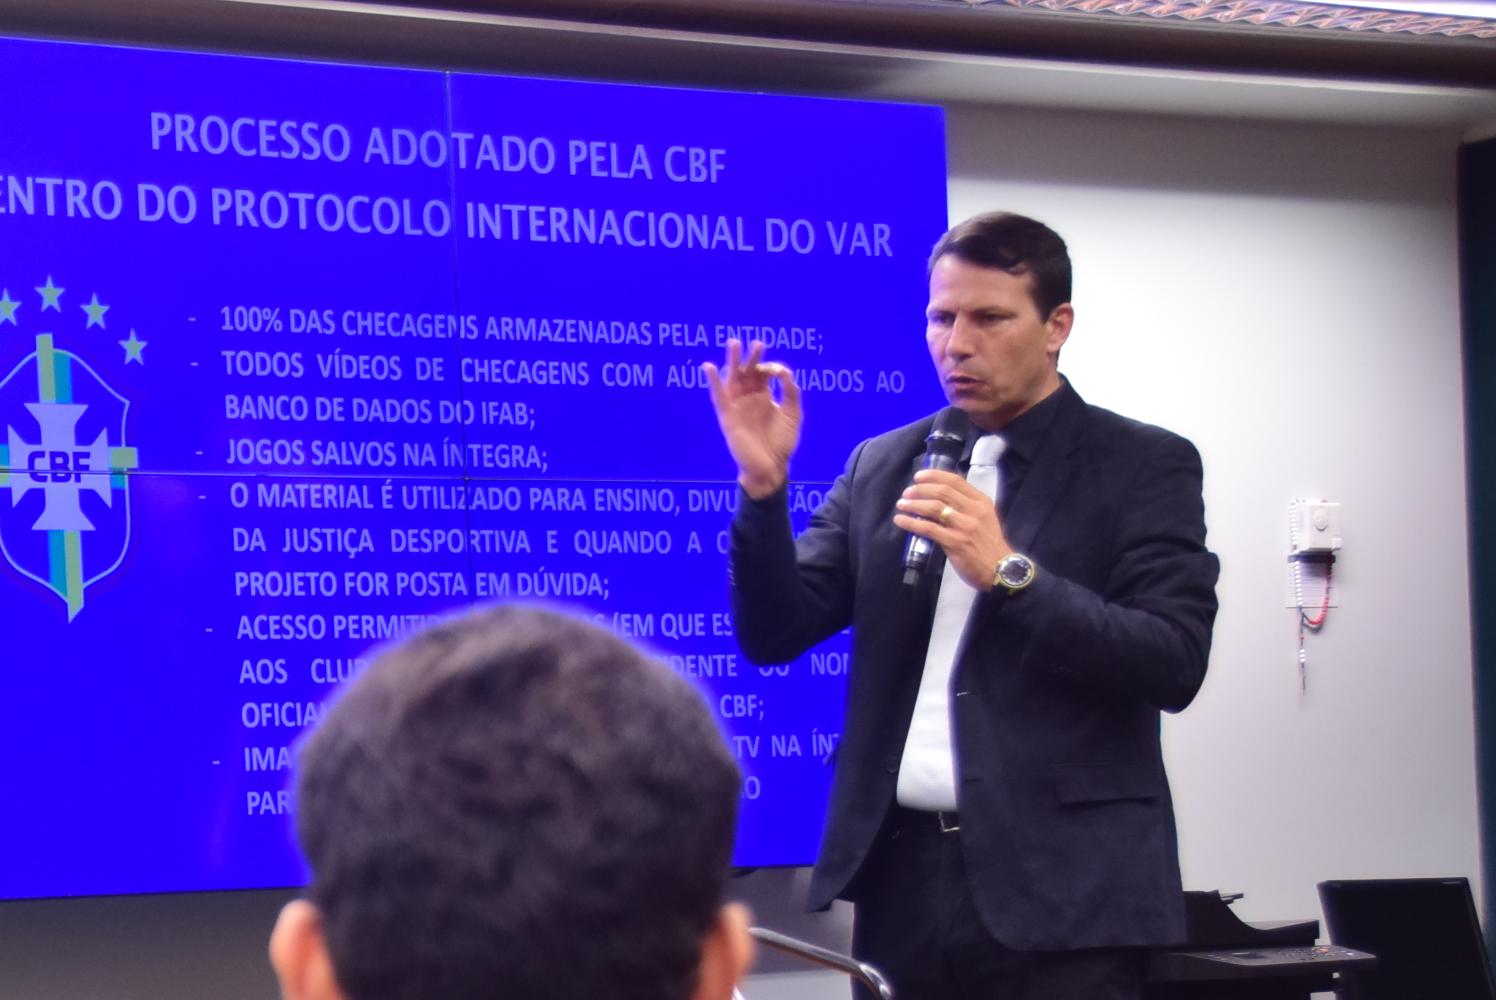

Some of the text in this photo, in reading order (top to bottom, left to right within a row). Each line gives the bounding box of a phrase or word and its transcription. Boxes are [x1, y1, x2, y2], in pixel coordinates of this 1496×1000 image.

[151, 112, 726, 183] PROCESSO ADOTADO PELA CBF
[137, 183, 197, 223] DO
[211, 188, 451, 237] PROTOCOLO
[466, 202, 754, 251] INTERNACIONAL
[766, 218, 815, 254] DO
[826, 221, 893, 257] VAR
[221, 306, 824, 355] 100% DAS CHECAGENS ARMAZENADAS PELA ENTIDADE;
[221, 348, 905, 393] TODOS VÍDEOS DE CHECAGENS COM AÚD VIADOS AO
[225, 395, 536, 431] BANCO DE DADOS DO IFAB;
[27, 450, 91, 483] CBF
[226, 437, 548, 473] JOGOS SALVOS NA ÍNTEGRA;
[230, 479, 824, 517] O MATERIAL É UTILIZADO PARA ENSINO, DIVUÃO
[233, 527, 266, 552] DA
[282, 528, 374, 559] JUSTIÇA
[390, 529, 531, 553] DESPORTIVA
[546, 530, 559, 554] E
[573, 530, 672, 557] QUANDO
[686, 531, 702, 554] A
[235, 566, 610, 601] PROJETO FOR POSTA EM DÚVIDA;
[237, 614, 326, 640] ACESSO
[333, 614, 454, 639] PERMITI
[613, 611, 654, 637] (EM
[660, 613, 706, 641] QUE
[239, 658, 288, 684] AOS
[719, 694, 765, 722] CBF;
[771, 734, 802, 758] NA
